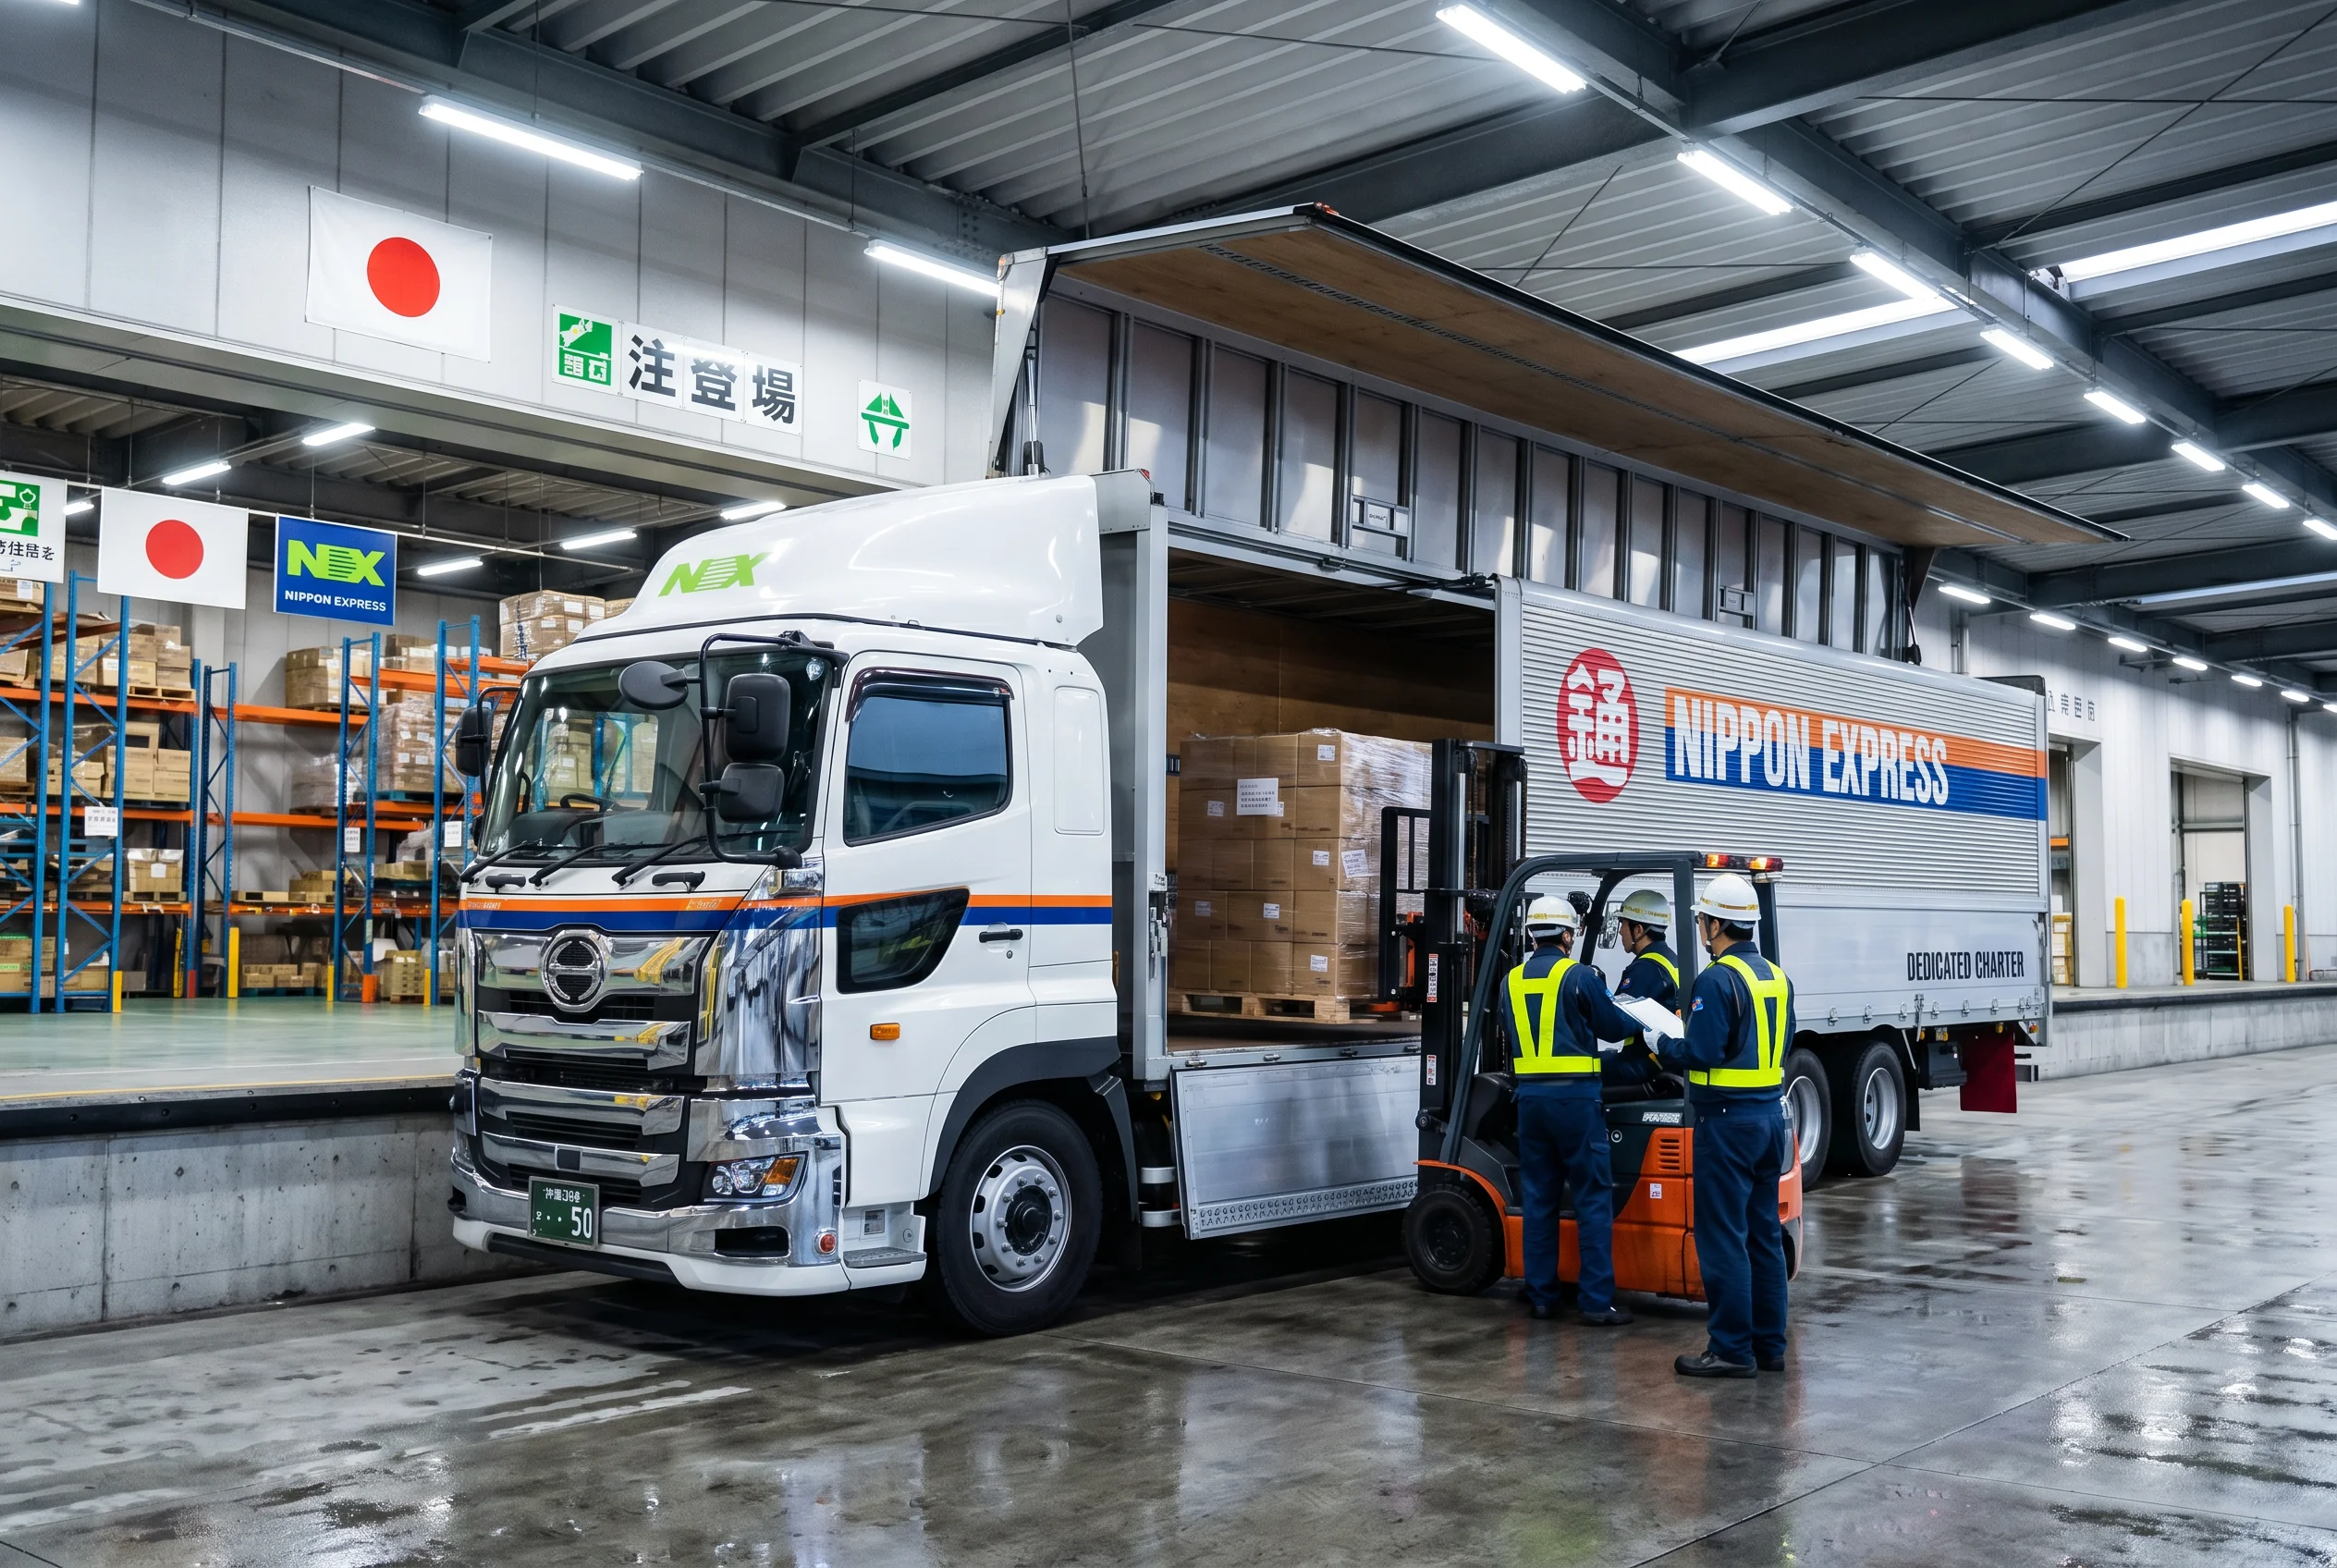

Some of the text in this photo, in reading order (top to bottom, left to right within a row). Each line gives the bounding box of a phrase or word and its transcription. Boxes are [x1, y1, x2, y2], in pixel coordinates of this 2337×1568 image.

[629, 334, 795, 424] 注登場
[287, 539, 385, 587] NEX
[657, 552, 773, 597] NEX
[285, 590, 386, 611] NIPPON EXPRESS
[1674, 695, 1949, 805] NIPPON EXPRESS
[1907, 950, 2025, 981] DEDICATED CHARTER
[571, 1206, 593, 1239] 50
